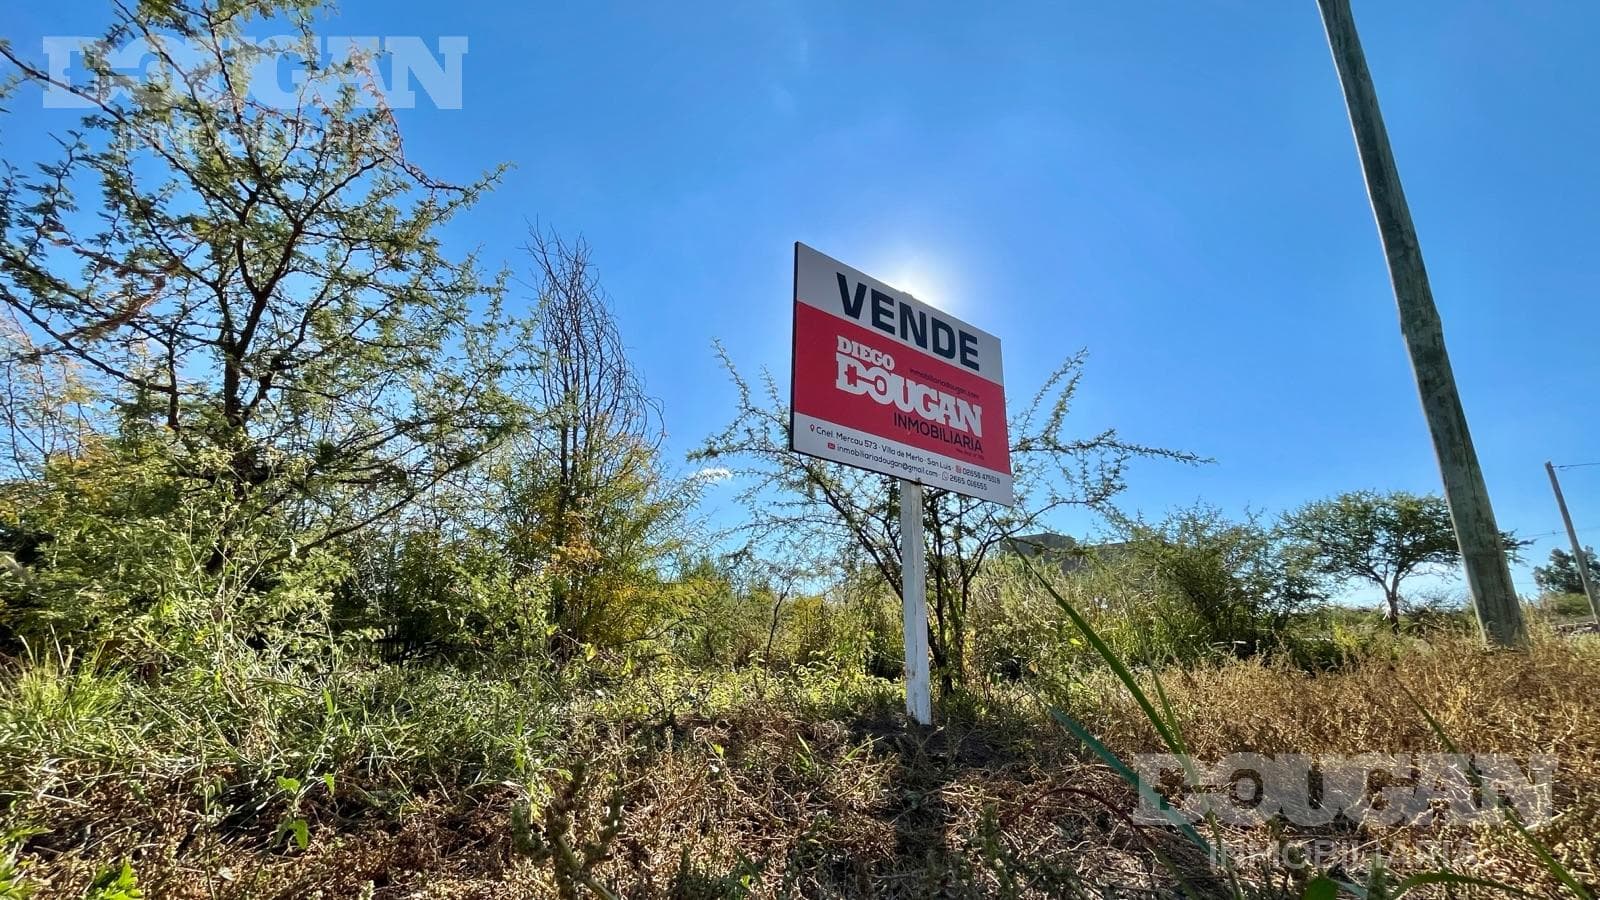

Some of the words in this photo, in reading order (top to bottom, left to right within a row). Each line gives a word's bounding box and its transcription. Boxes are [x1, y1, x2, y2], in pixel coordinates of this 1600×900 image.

[836, 271, 980, 372] VENDE
[836, 335, 896, 371] DIEGO
[835, 352, 983, 438] DOUGAN
[816, 426, 834, 438] Cnel.
[836, 431, 864, 446] Mercau
[864, 439, 878, 450] 573
[881, 444, 896, 455] Villa
[896, 449, 905, 458] de
[905, 452, 924, 463] Merlo
[927, 457, 939, 467] San
[940, 463, 952, 471] Luis
[893, 412, 984, 454] INMOBILIARIA
